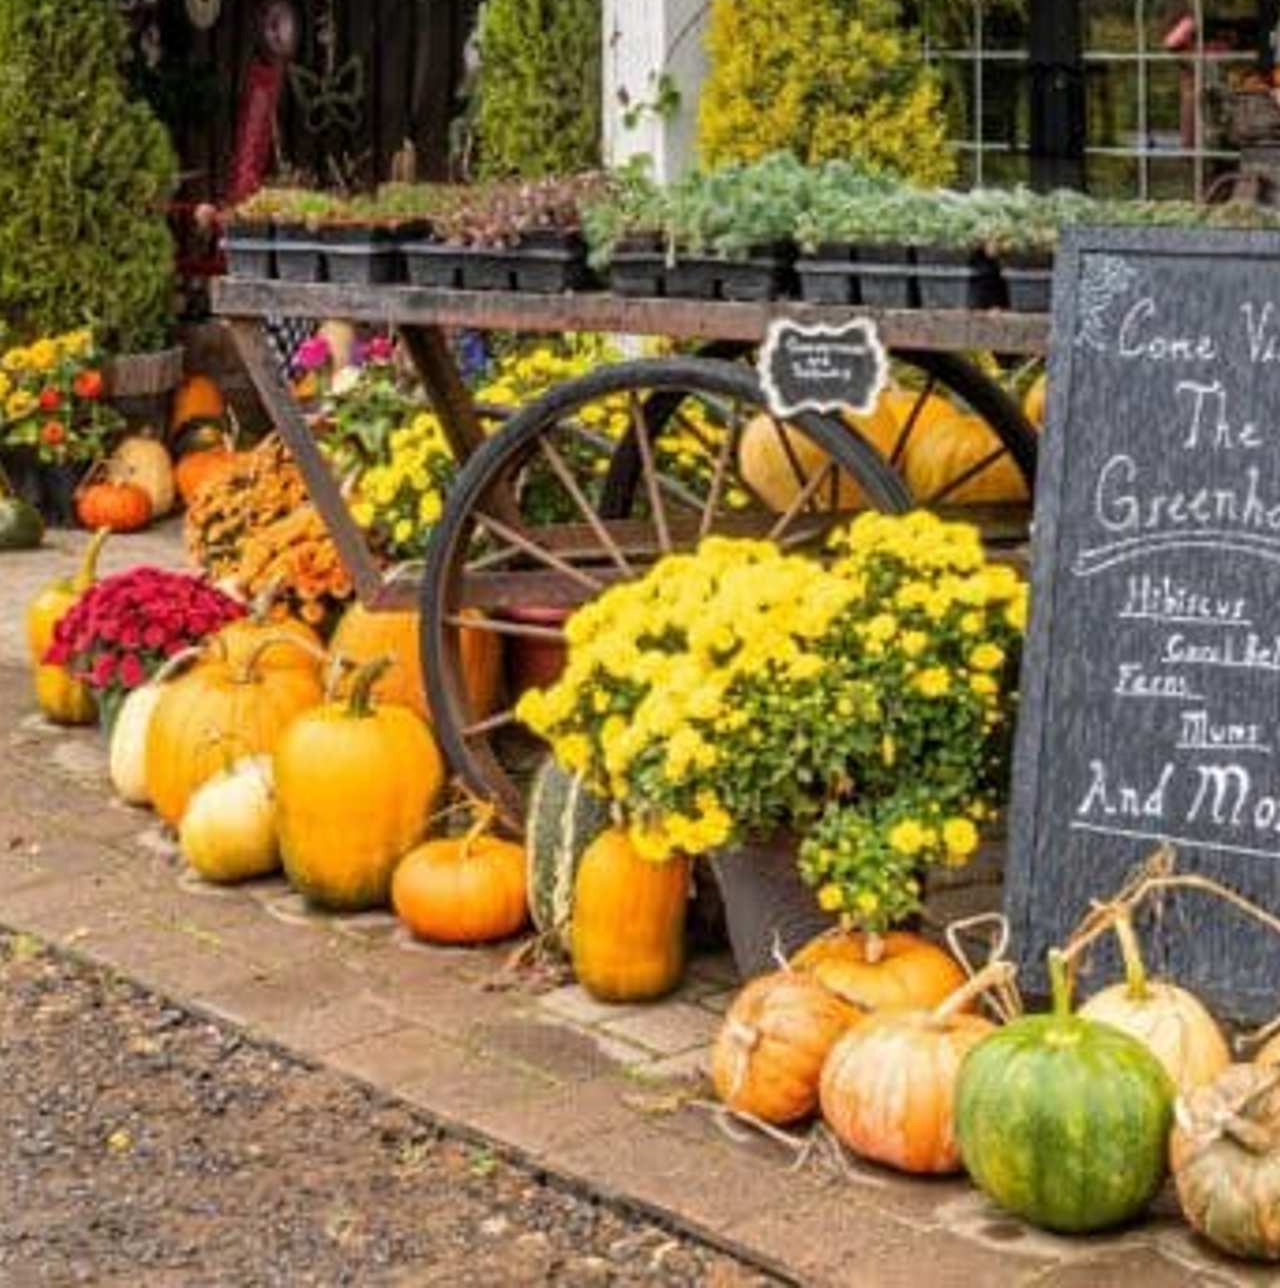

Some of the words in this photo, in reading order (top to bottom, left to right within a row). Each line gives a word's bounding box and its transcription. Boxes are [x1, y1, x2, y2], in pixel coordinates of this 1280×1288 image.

[1119, 297, 1218, 360] Come
[1175, 380, 1262, 450] The
[1122, 575, 1246, 619] Hibiscus
[1180, 710, 1260, 745] Mums
[1077, 758, 1174, 816] And
